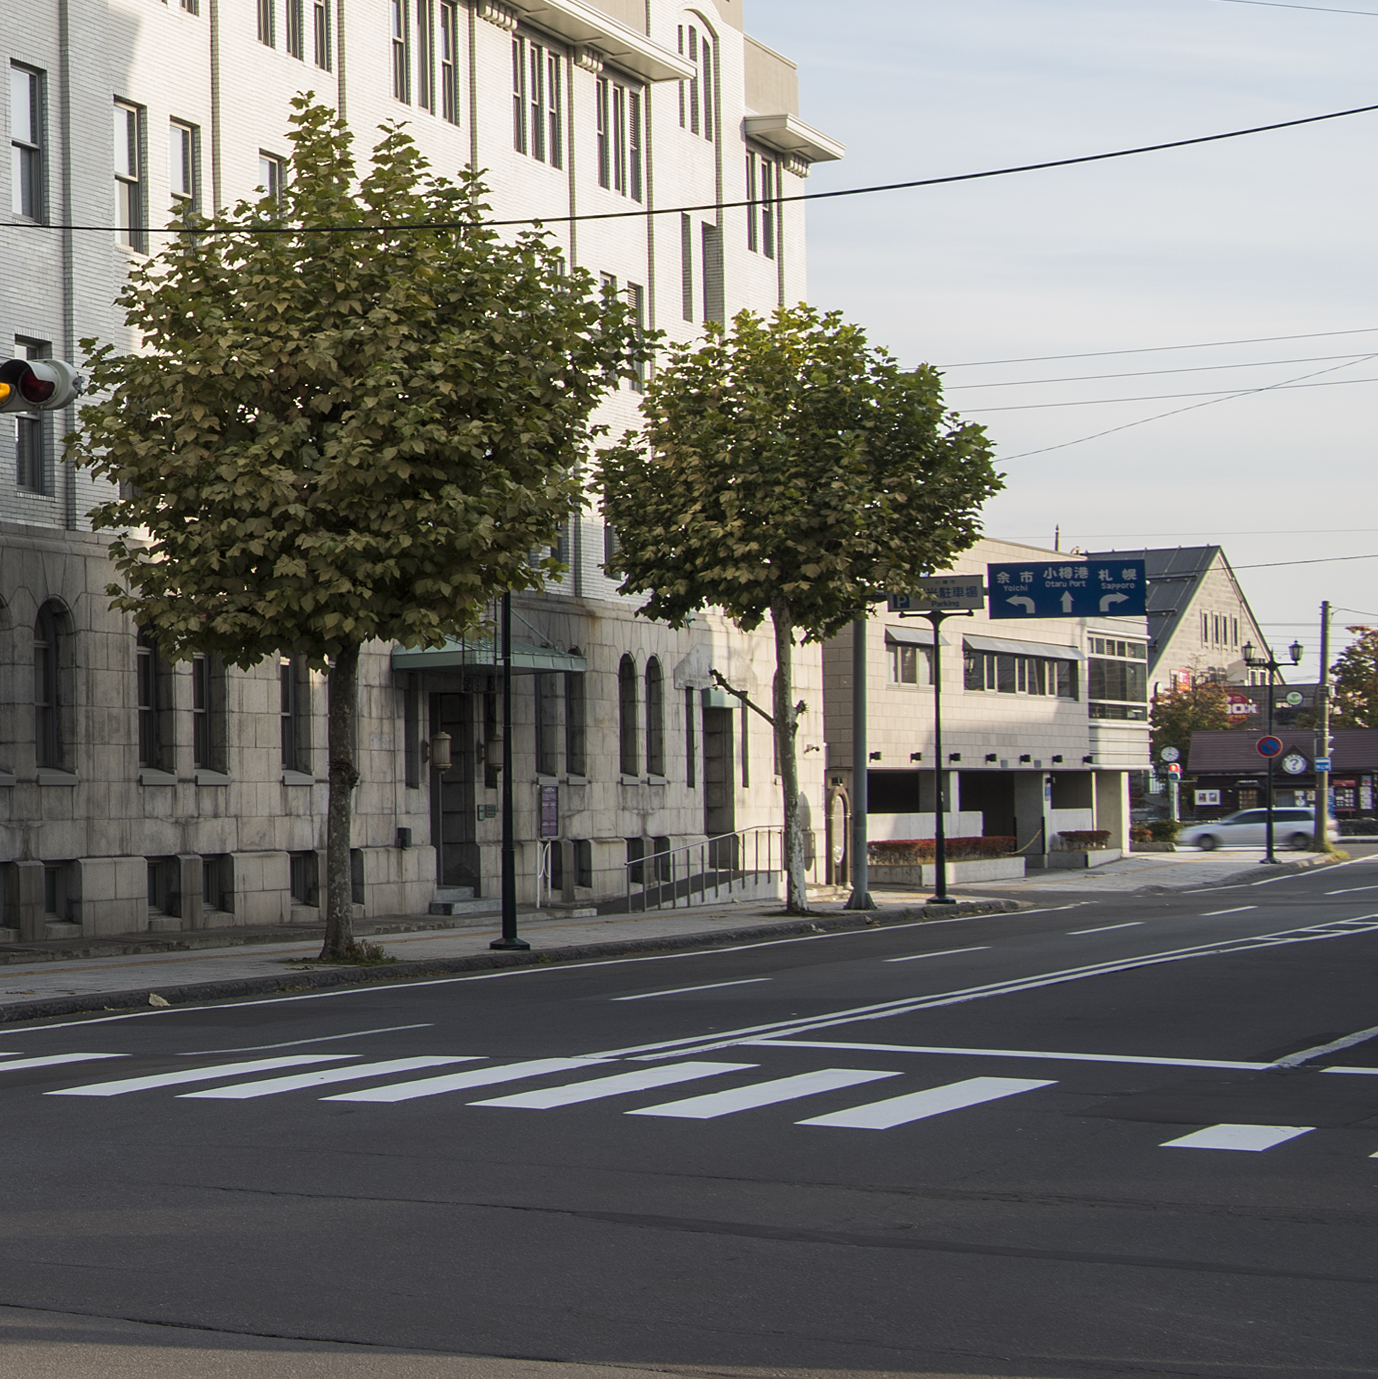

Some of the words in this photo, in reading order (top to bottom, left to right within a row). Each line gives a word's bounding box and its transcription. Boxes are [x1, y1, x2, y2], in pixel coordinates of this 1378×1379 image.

[996, 570, 1034, 584] 余市
[1043, 566, 1089, 580] 小樽港
[1097, 568, 1137, 582] 札幌
[1003, 584, 1028, 592] Yoichi
[1045, 580, 1068, 588] Otaru
[1101, 582, 1135, 590] Sapporo
[923, 586, 978, 599] 光駐車場
[931, 600, 960, 608] Parking
